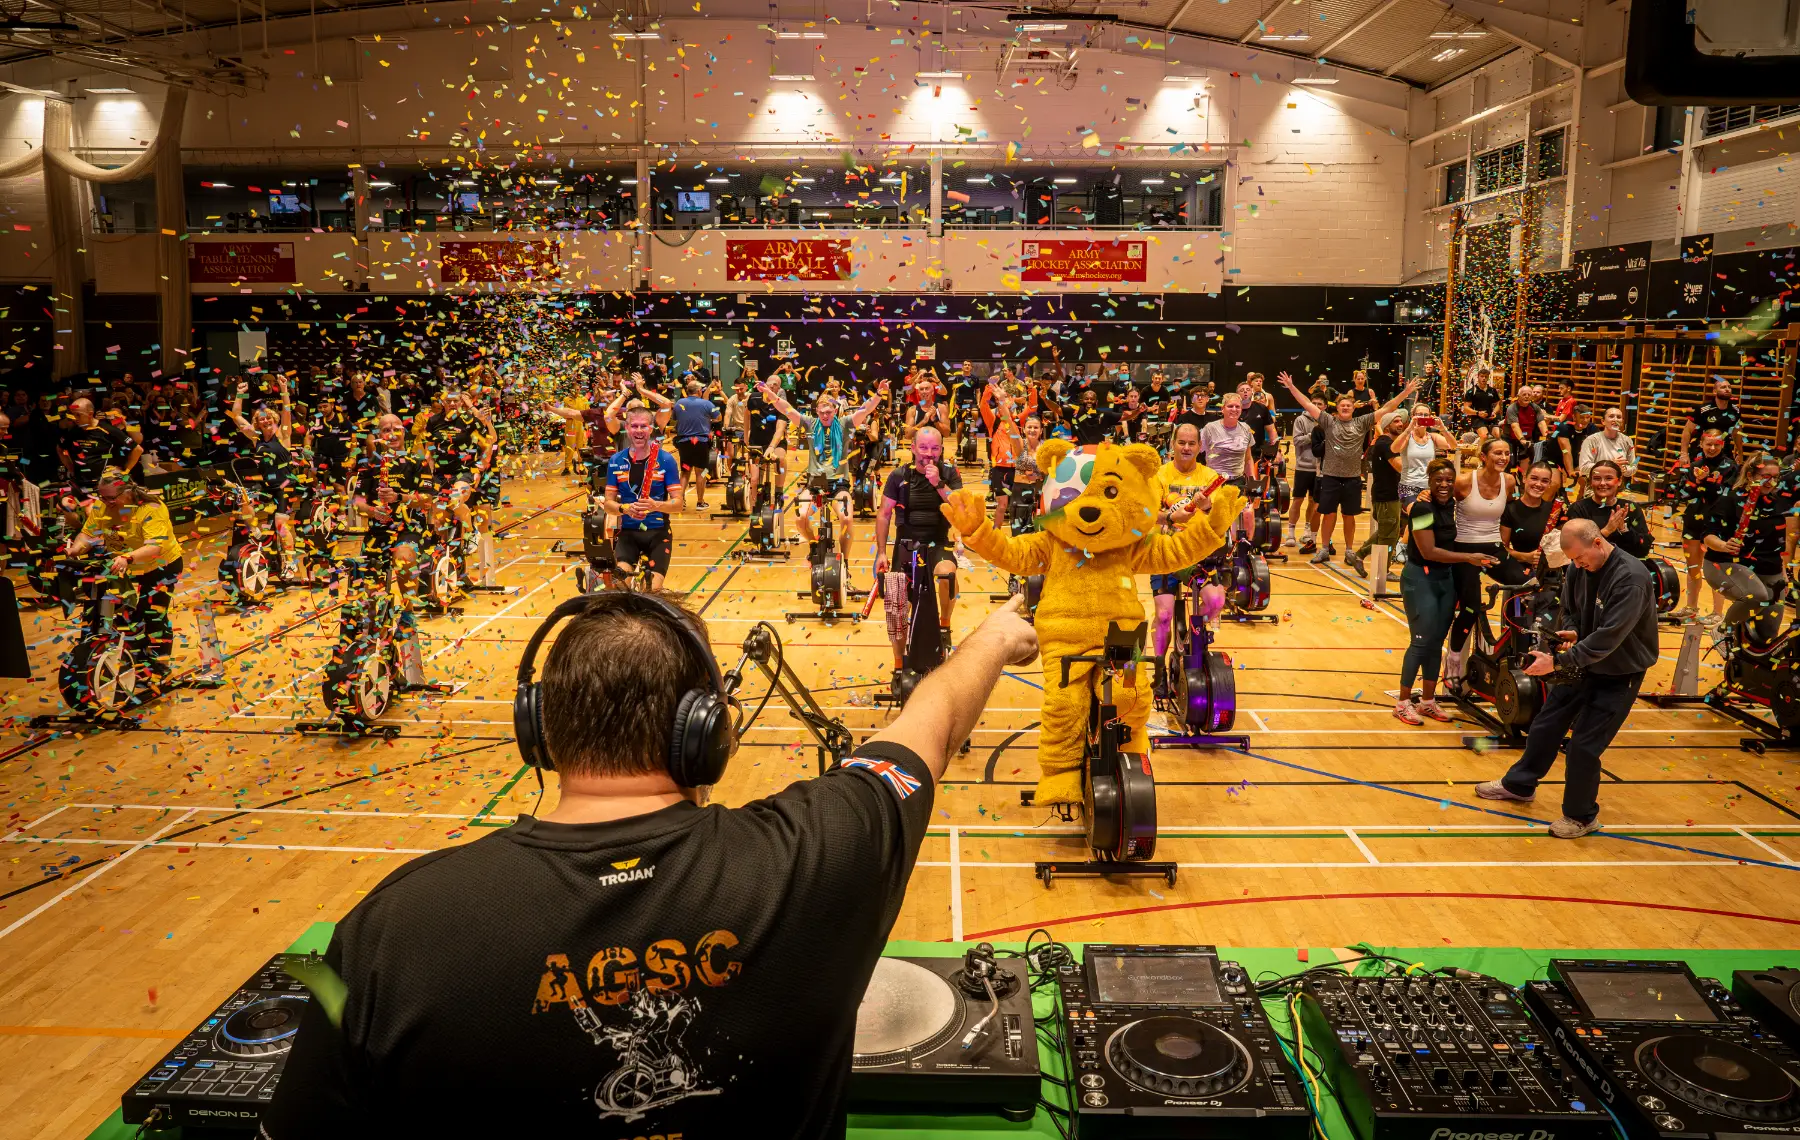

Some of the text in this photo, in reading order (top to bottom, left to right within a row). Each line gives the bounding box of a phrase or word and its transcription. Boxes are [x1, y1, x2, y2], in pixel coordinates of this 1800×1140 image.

[222, 244, 252, 253] ARMY
[764, 241, 814, 255] ARMY
[201, 254, 277, 264] TABLE TENNIS
[1068, 249, 1101, 259] ARMY
[750, 256, 827, 270] NETBALL
[1027, 260, 1142, 270] HOCKEY ASSOCIATION
[203, 264, 274, 274] ASSOCIATION
[599, 867, 654, 887] TROJAN
[531, 929, 743, 1015] AGSC
[1554, 1026, 1599, 1081] Pioneer
[188, 1109, 238, 1118] DENON
[1743, 1124, 1791, 1132] Pioneer
[1430, 1127, 1525, 1140] Pioneer
